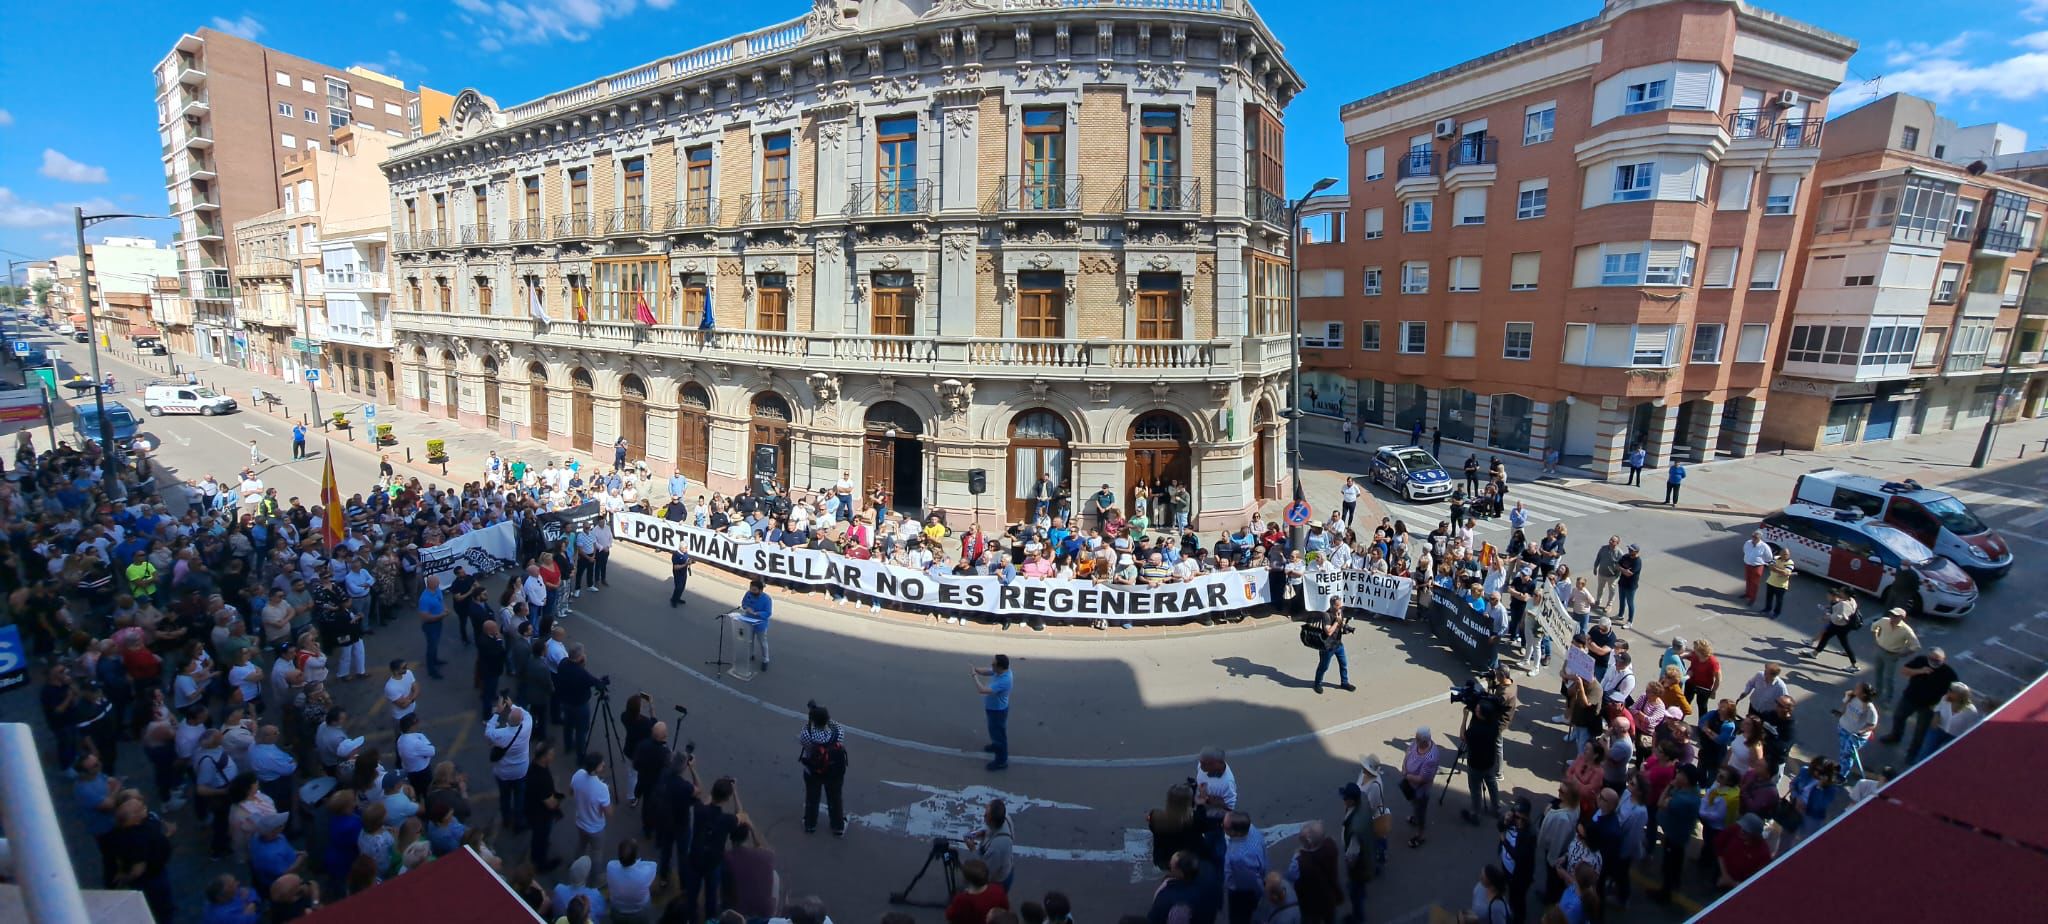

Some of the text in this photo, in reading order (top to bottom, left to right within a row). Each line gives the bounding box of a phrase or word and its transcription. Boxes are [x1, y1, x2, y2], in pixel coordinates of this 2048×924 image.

[635, 520, 743, 565] PORTMÁN.
[754, 549, 861, 589] SELLAR
[876, 572, 925, 601] NO
[938, 584, 984, 607] ES
[1000, 582, 1229, 614] REGENERAR
[1316, 571, 1400, 590] REGENERACION
[1318, 583, 1396, 601] DE LA BAHIA
